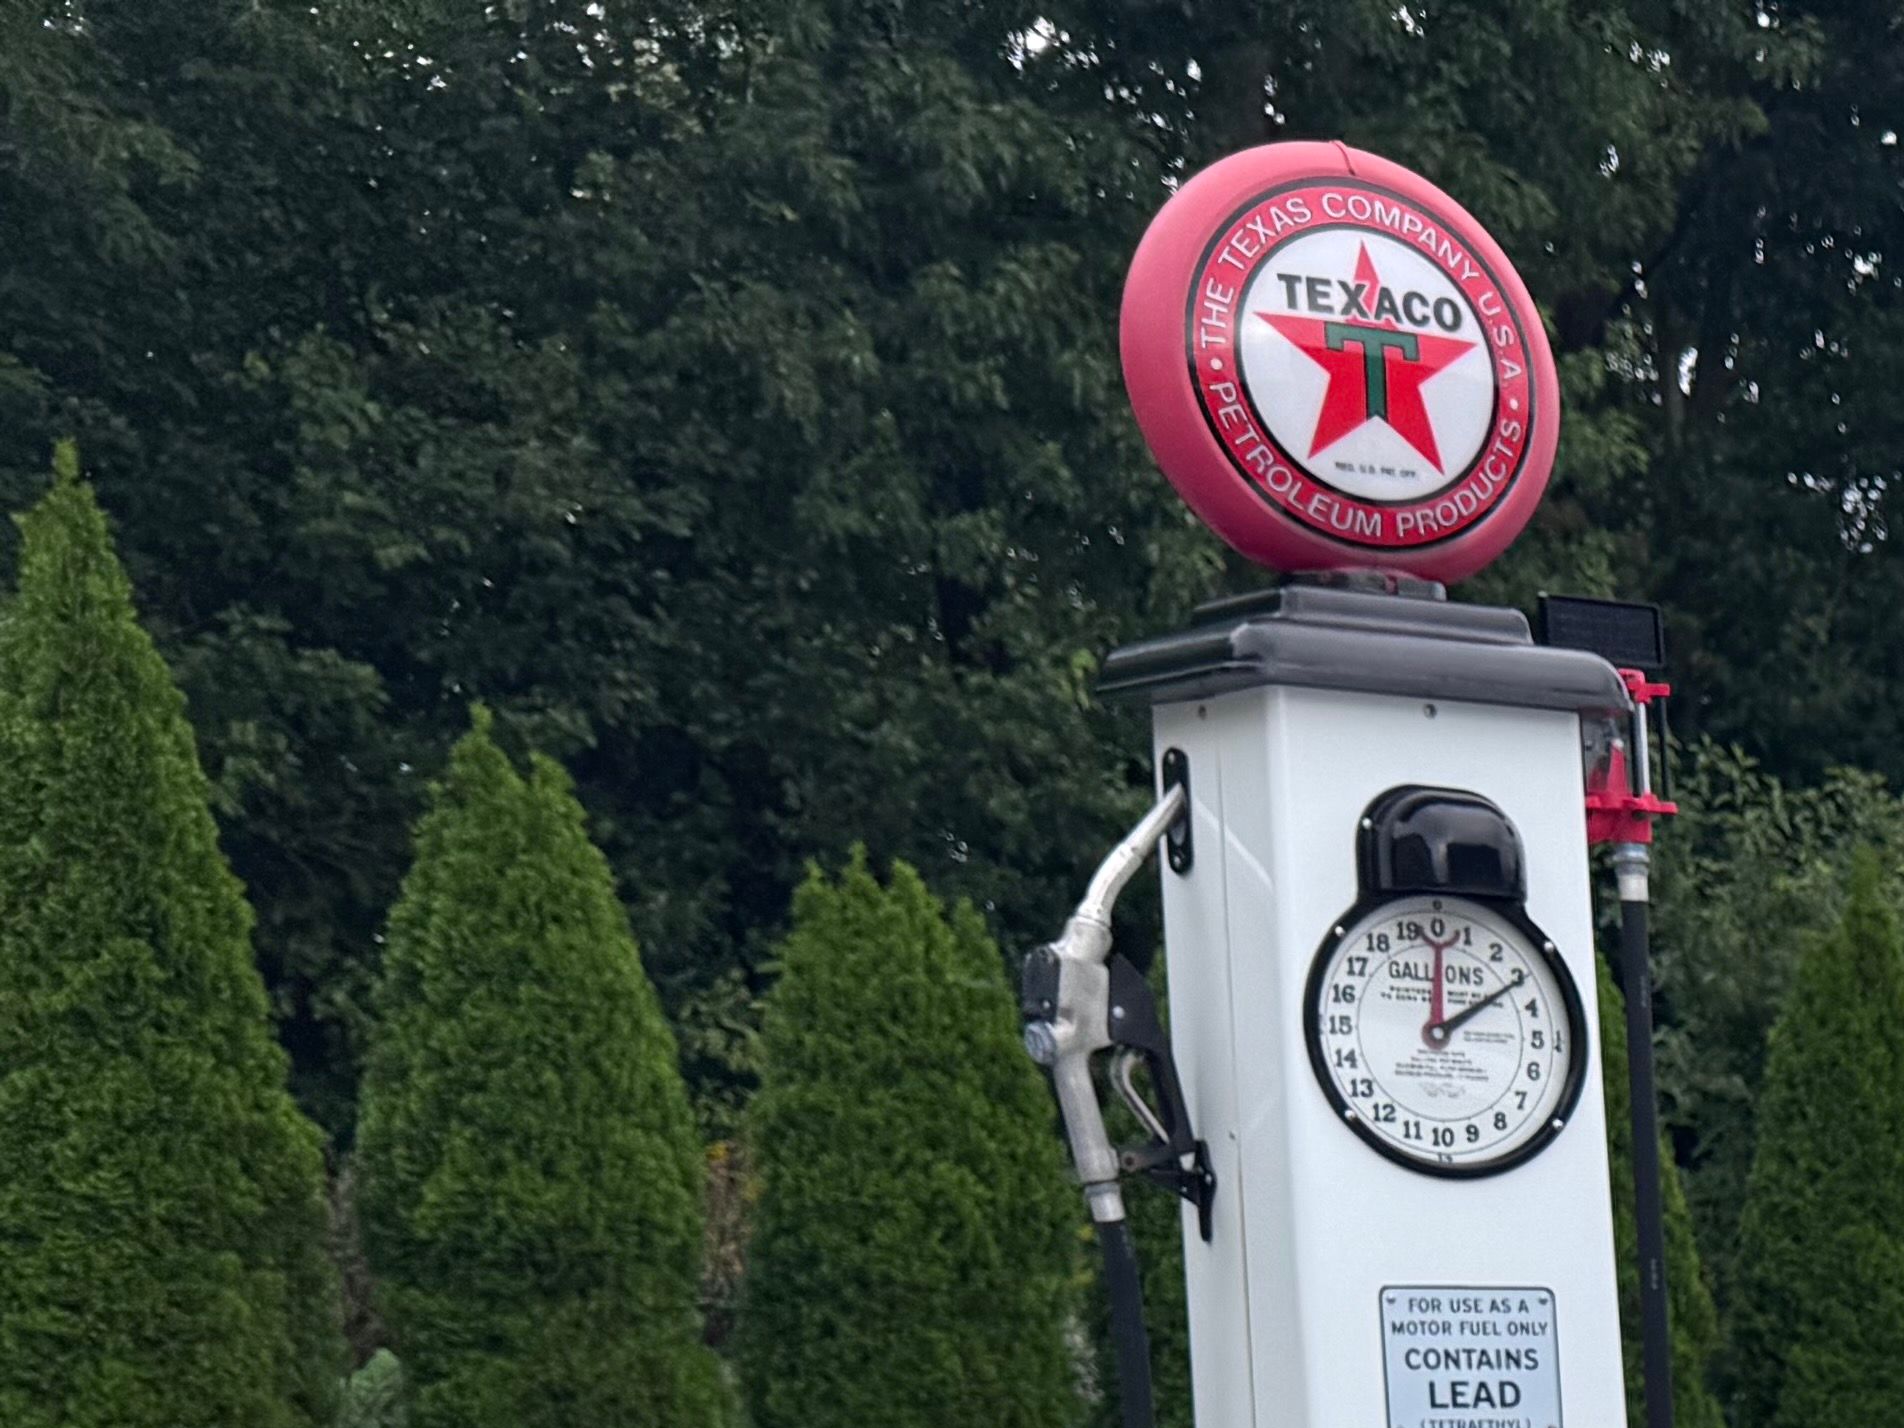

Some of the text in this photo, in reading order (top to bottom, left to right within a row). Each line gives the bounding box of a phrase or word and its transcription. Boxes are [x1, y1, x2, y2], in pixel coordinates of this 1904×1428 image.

[1201, 277, 1235, 349] THE
[1218, 196, 1315, 271] TEXAS
[1321, 192, 1480, 281] COMPANY
[1276, 272, 1463, 333] TEXACO
[1323, 320, 1421, 422] T
[1208, 378, 1522, 538] PETROLEUM PRODUCTS
[1396, 921, 1421, 941] 19
[1430, 917, 1445, 937] 0
[1463, 927, 1472, 946] 1
[1366, 933, 1390, 952] 18
[1489, 943, 1504, 962] 2
[1346, 957, 1369, 977] 17
[1389, 960, 1484, 986] GALLONS
[1511, 968, 1526, 987] 3
[1332, 984, 1356, 1003] 16
[1525, 998, 1539, 1018] 4
[1328, 1015, 1353, 1035] 15
[1530, 1031, 1545, 1049] 5
[1334, 1050, 1358, 1068] 14
[1527, 1062, 1541, 1081] 6
[1350, 1079, 1374, 1097] 13
[1514, 1091, 1528, 1110] 7
[1372, 1103, 1397, 1123] 12
[1493, 1112, 1507, 1131] 8
[1403, 1121, 1423, 1140] 11
[1432, 1128, 1455, 1147] 10
[1466, 1124, 1480, 1143] 9
[1408, 1298, 1530, 1314] FOR USE AS A
[1391, 1321, 1548, 1336] MOTOR FUEL ONLY
[1404, 1348, 1539, 1371] CONTAINS
[1429, 1380, 1521, 1410] LEAD
